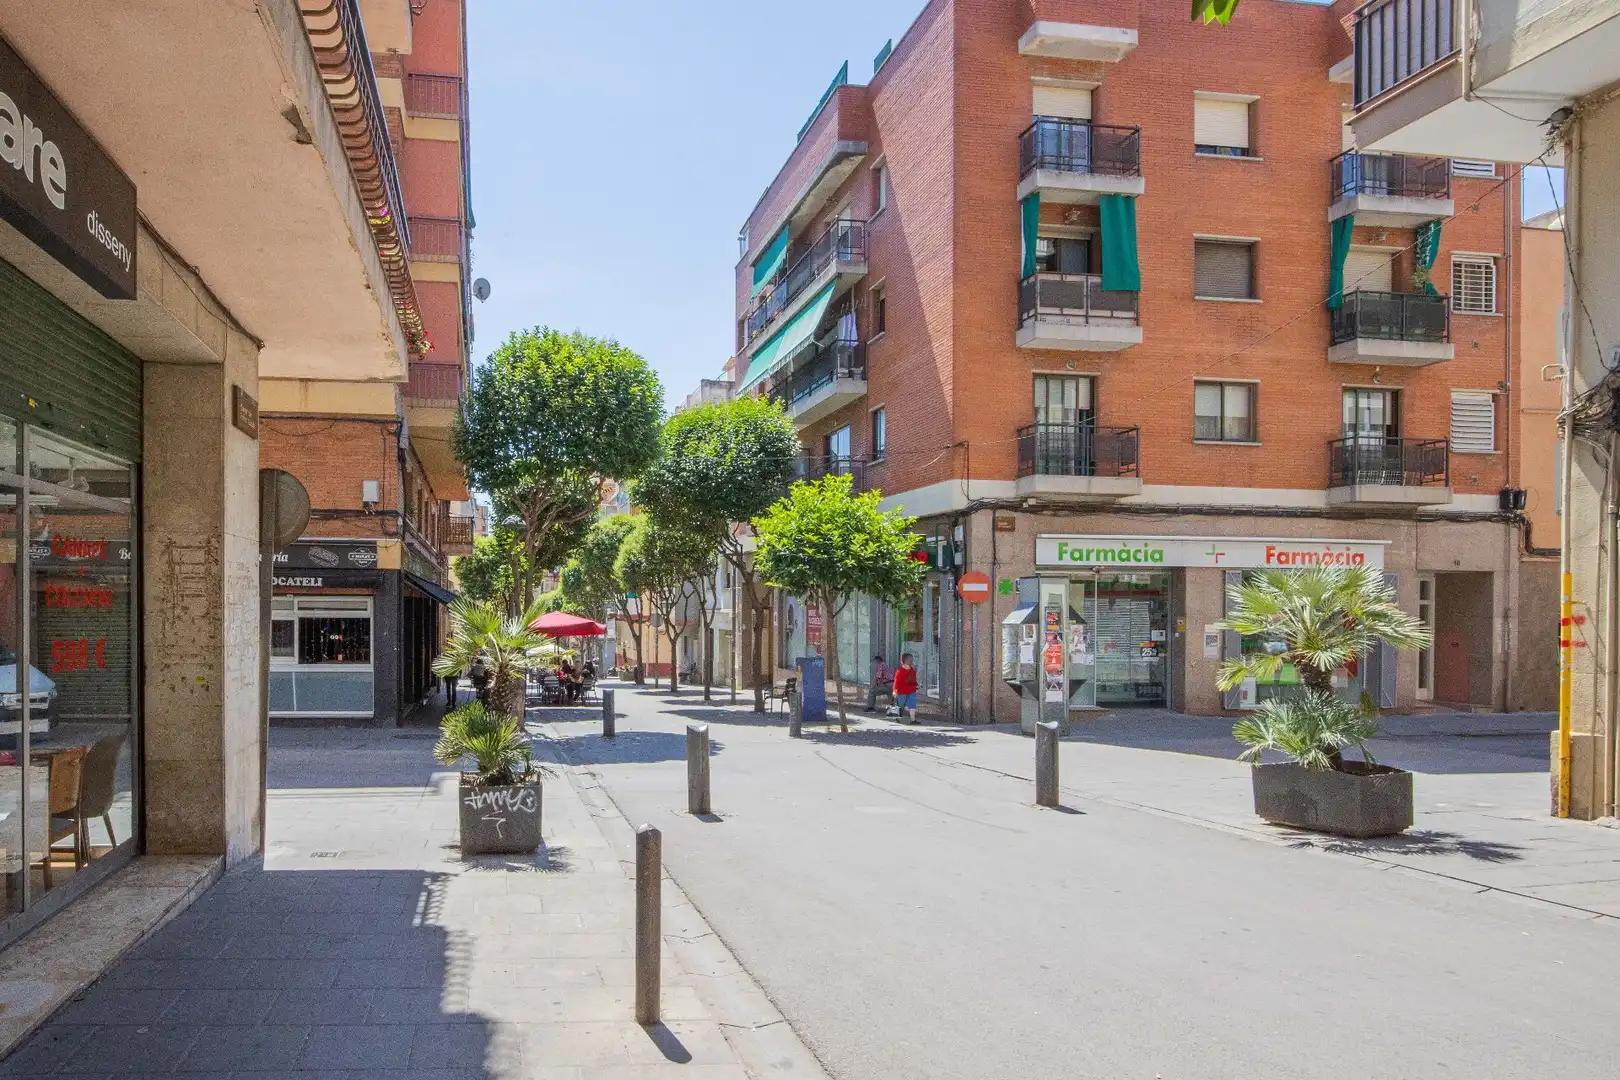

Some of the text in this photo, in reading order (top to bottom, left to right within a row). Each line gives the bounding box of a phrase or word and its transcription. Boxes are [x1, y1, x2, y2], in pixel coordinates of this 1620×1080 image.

[86, 209, 132, 272] disseny
[1057, 542, 1165, 563] Farmàcia
[1265, 545, 1365, 567] Farmàcia
